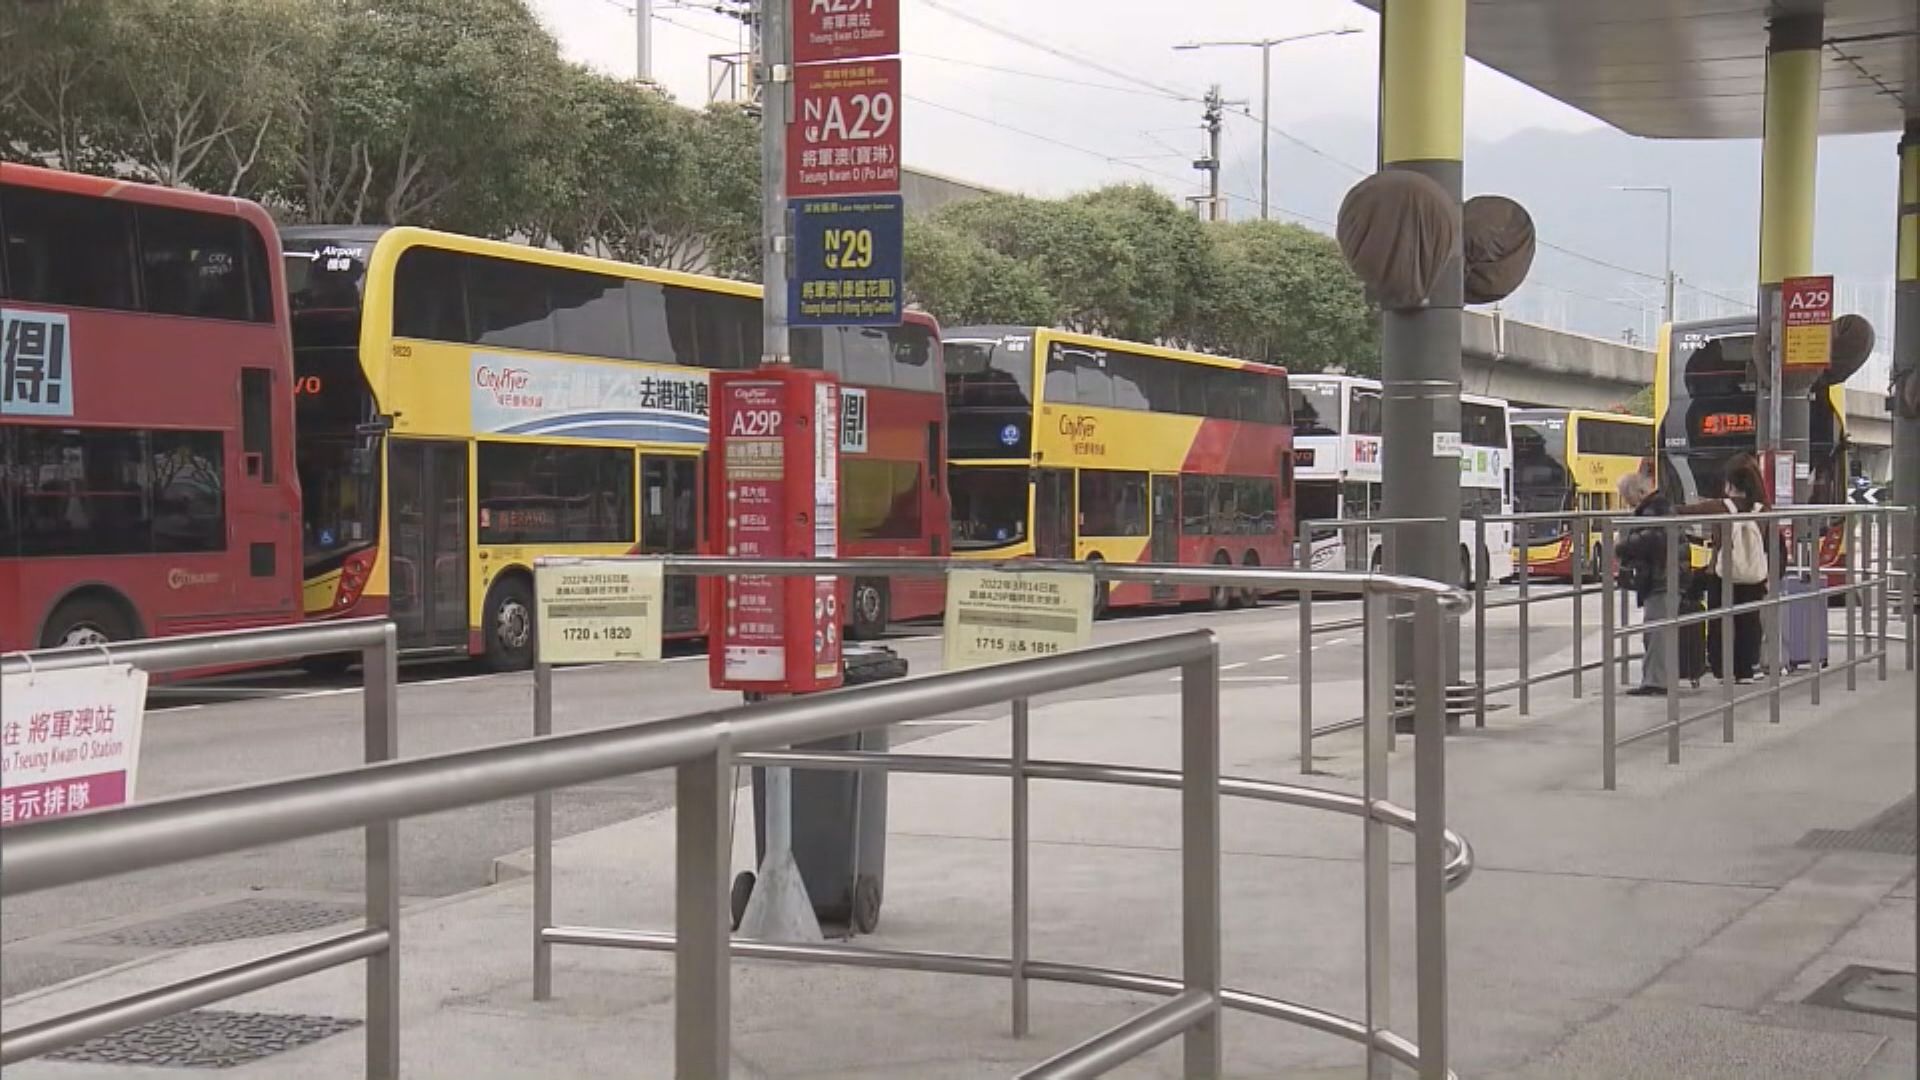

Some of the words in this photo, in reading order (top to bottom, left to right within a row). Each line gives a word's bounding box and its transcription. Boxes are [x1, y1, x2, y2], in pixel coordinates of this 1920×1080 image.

[321, 245, 362, 258] Airport
[1790, 290, 1830, 310] A29
[640, 376, 710, 417] 去港珠澳
[731, 409, 782, 436] A29P
[563, 628, 590, 641] 1720
[603, 627, 633, 640] 1820
[976, 637, 1004, 650] 1715
[4, 721, 21, 747] 往
[28, 703, 116, 744] 將軍澳站
[14, 751, 49, 773] Tseung
[51, 746, 78, 766] Kwan
[80, 741, 88, 761] O
[91, 739, 123, 760] Station
